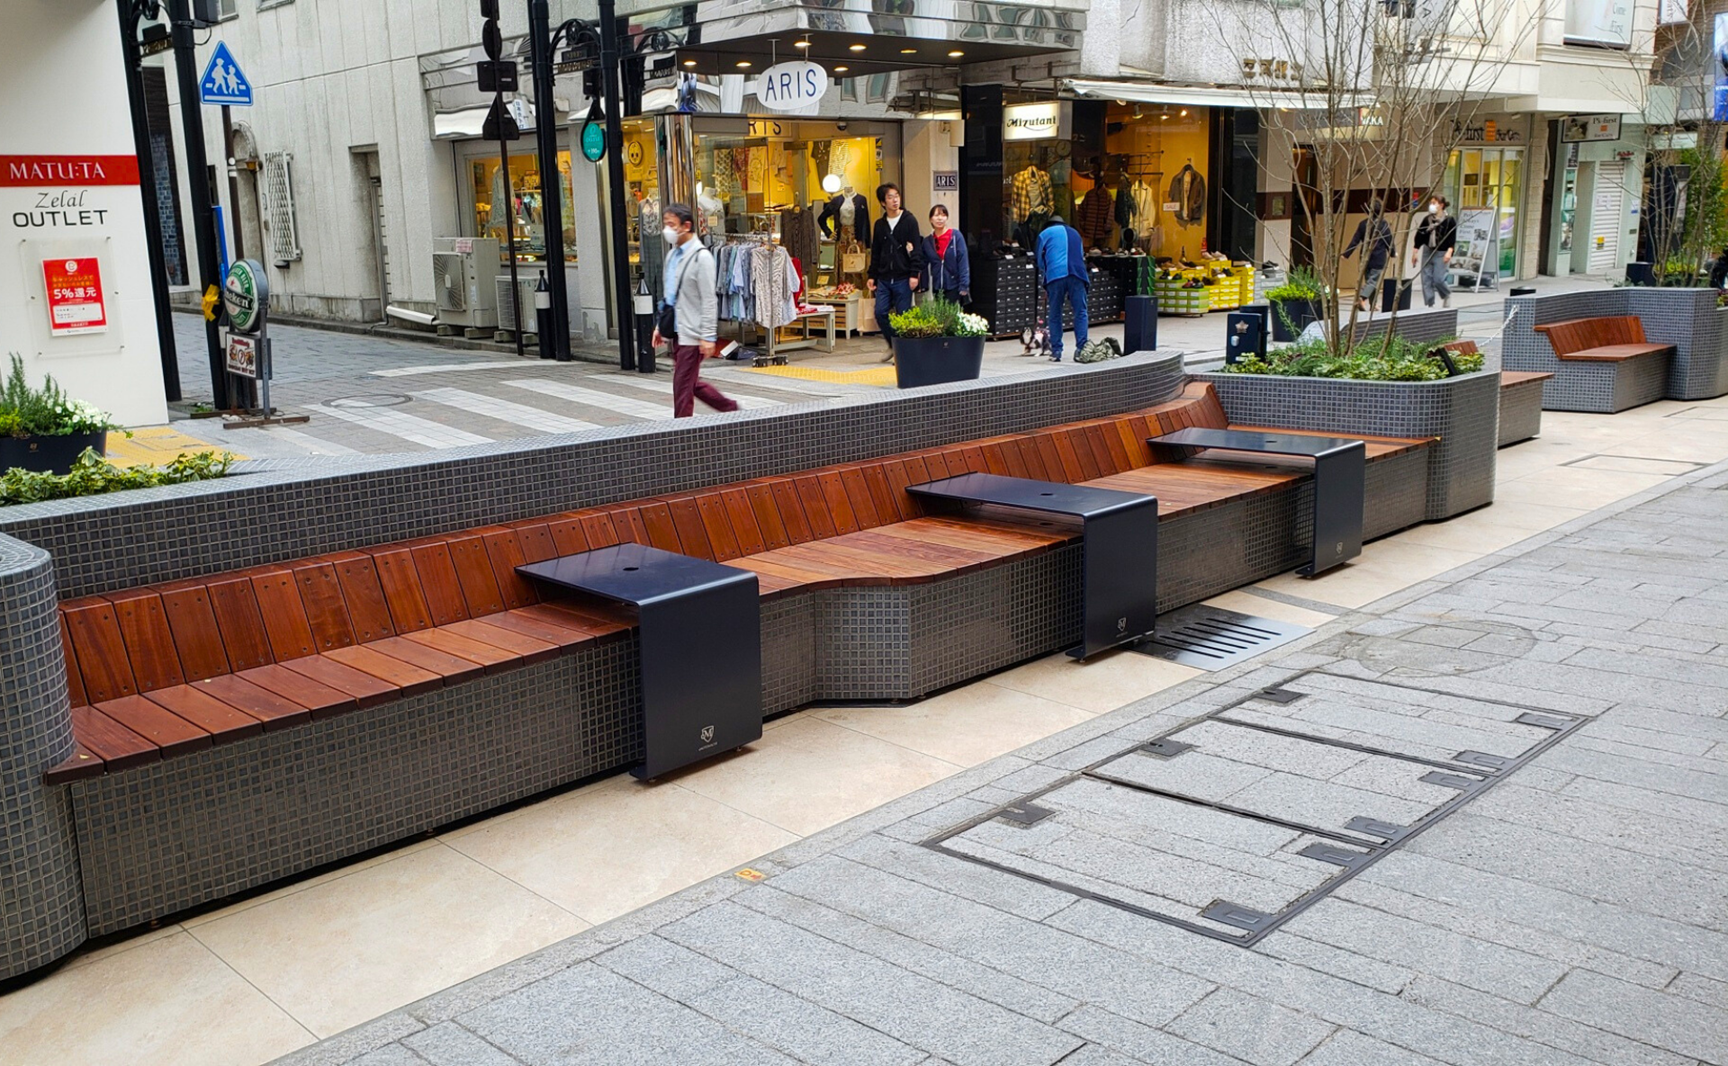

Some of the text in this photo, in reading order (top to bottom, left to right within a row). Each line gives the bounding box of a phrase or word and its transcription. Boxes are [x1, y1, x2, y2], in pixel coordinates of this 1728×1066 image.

[765, 69, 816, 102] ARIS
[748, 121, 782, 135] RIS
[1006, 115, 1056, 128] Mizutani
[9, 162, 106, 180] MATU:TA
[936, 175, 956, 187] ARIS
[12, 209, 108, 228] OUTLET
[54, 287, 97, 300] 5%還元
